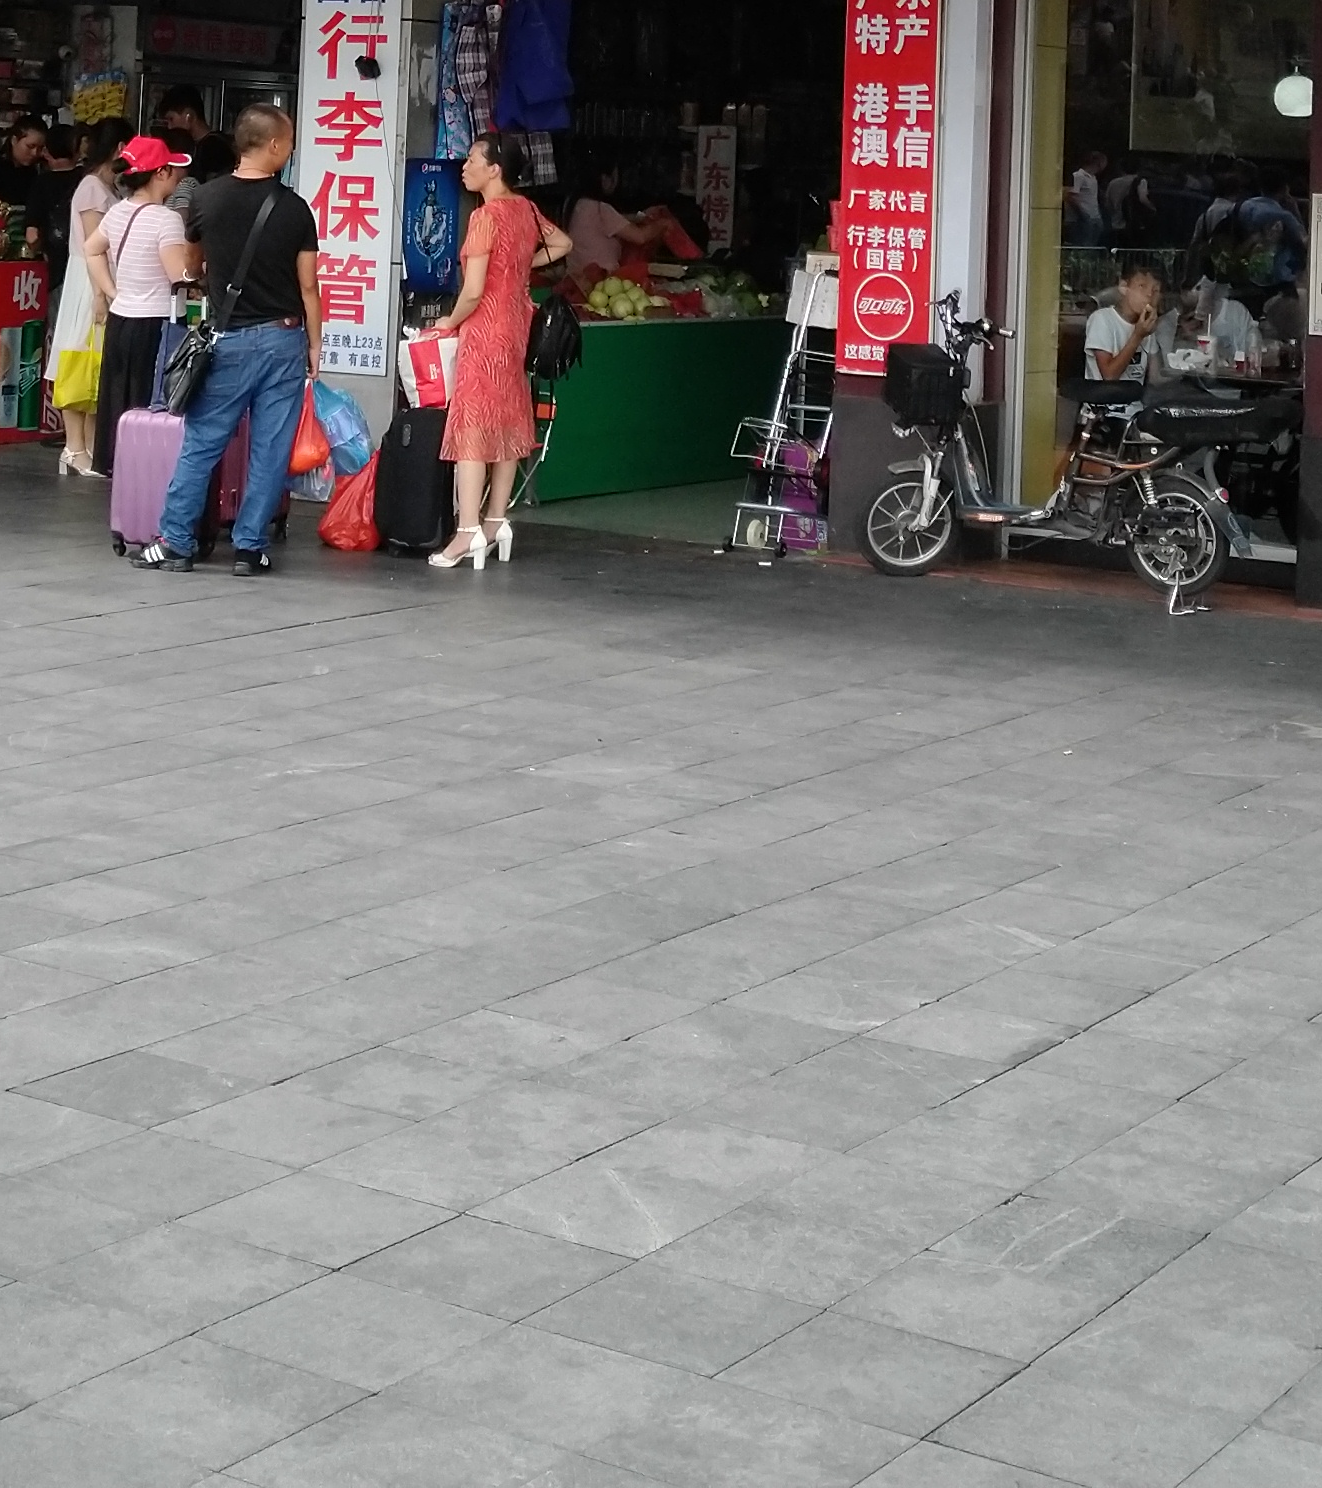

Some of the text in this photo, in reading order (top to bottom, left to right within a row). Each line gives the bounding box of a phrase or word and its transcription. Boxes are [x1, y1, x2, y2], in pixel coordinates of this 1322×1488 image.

[855, 13, 929, 56] 特产
[311, 10, 388, 325] 行李保管
[848, 188, 928, 213] 厂家代言
[846, 224, 926, 251] 行李保管
[13, 270, 42, 310] 收
[858, 297, 908, 316] 可口可乐
[843, 343, 885, 362] 这感觉
